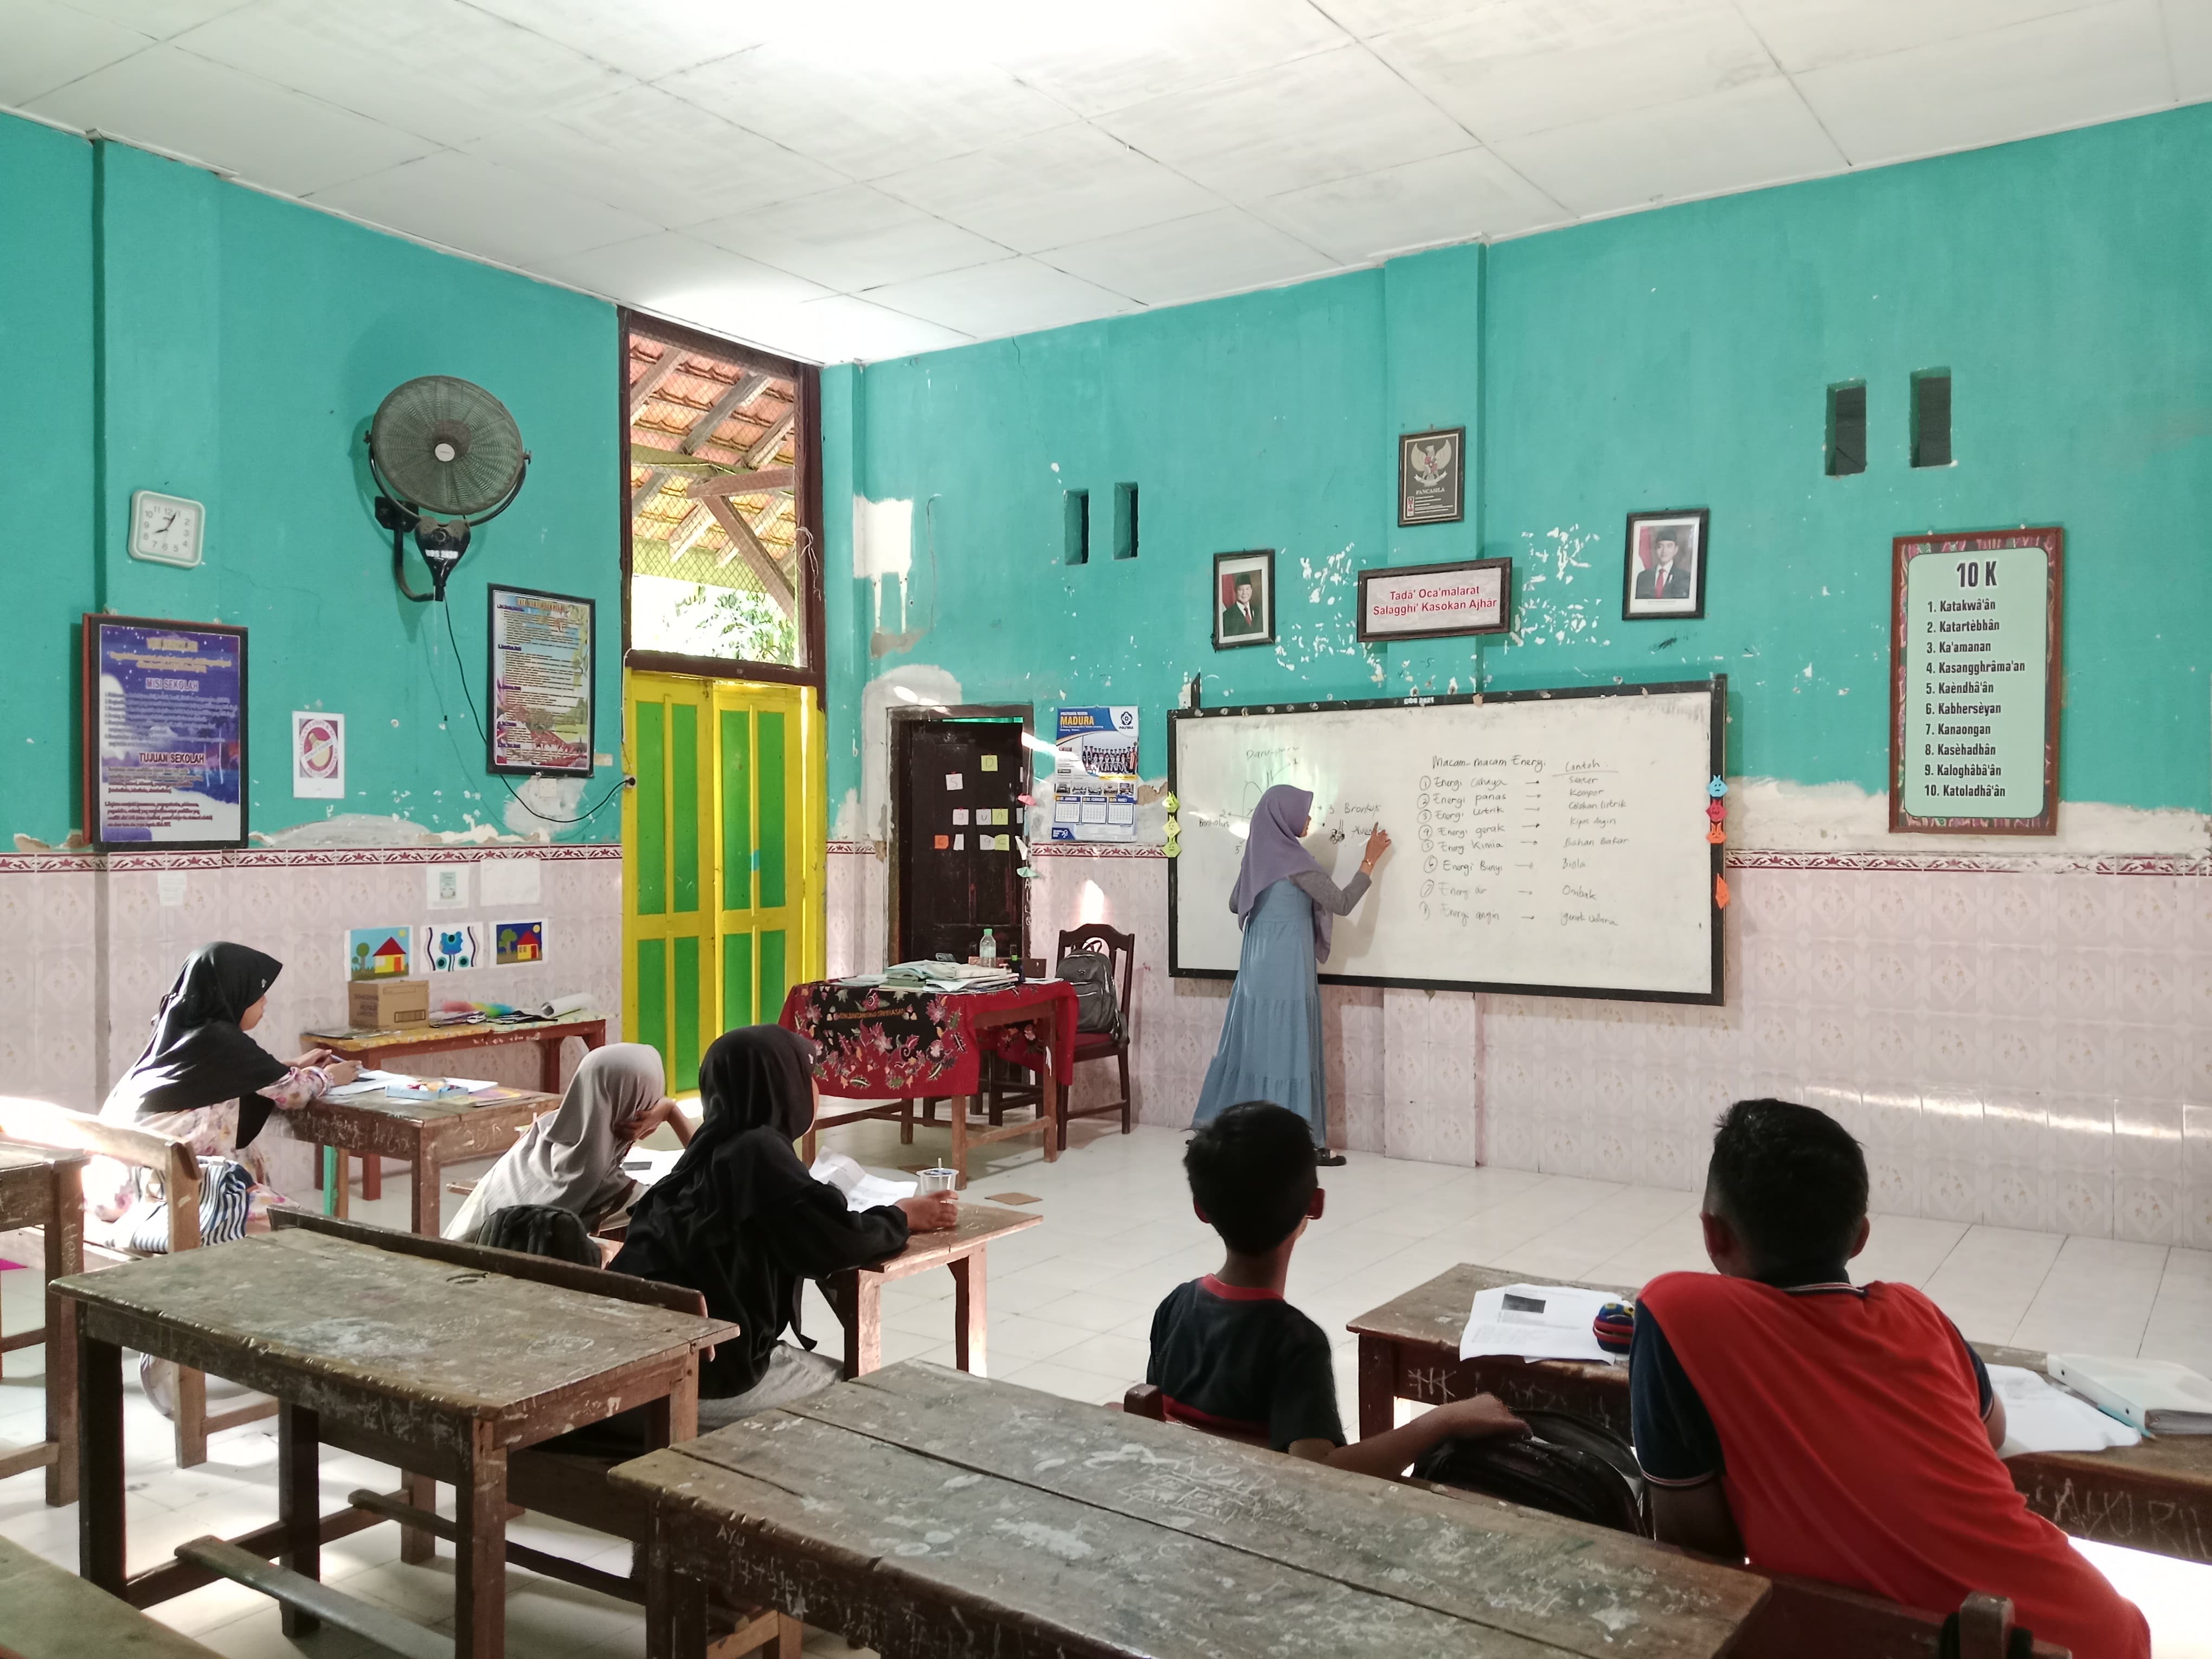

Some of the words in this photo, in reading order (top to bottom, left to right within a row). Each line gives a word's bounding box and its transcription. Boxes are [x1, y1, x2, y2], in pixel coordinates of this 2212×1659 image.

[1416, 487, 1445, 495] PANCASILA
[145, 510, 153, 518] 10
[1957, 562, 1978, 587] 10
[1985, 561, 1997, 586] K
[1373, 604, 1419, 616] Salagghi'
[1422, 601, 1466, 612] Kasokan
[1927, 601, 1936, 613] 1.
[1927, 622, 1936, 633] 2.
[1927, 642, 1935, 653] 3.
[1939, 641, 1991, 653] Ka'amanan
[1926, 662, 1935, 673] 4.
[1939, 660, 2025, 676] Kasangghrâma'an
[146, 678, 163, 689] MISI
[164, 678, 199, 691] SEKOLAH
[1926, 683, 1935, 694] 5.
[1926, 703, 1935, 715] 6.
[1938, 702, 2001, 716] Kabhersèyan
[1060, 716, 1095, 725] MADURA
[1925, 723, 1934, 735] 7.
[1938, 723, 1991, 737] Kanaongan
[1925, 744, 1934, 755] 8.
[139, 753, 168, 763] TUJUAN
[170, 753, 204, 764] SEKOLAH
[1925, 764, 1934, 776] 9.
[1433, 777, 1462, 791] Energi
[1925, 785, 1939, 796] 10.
[1433, 793, 1465, 808] Energi
